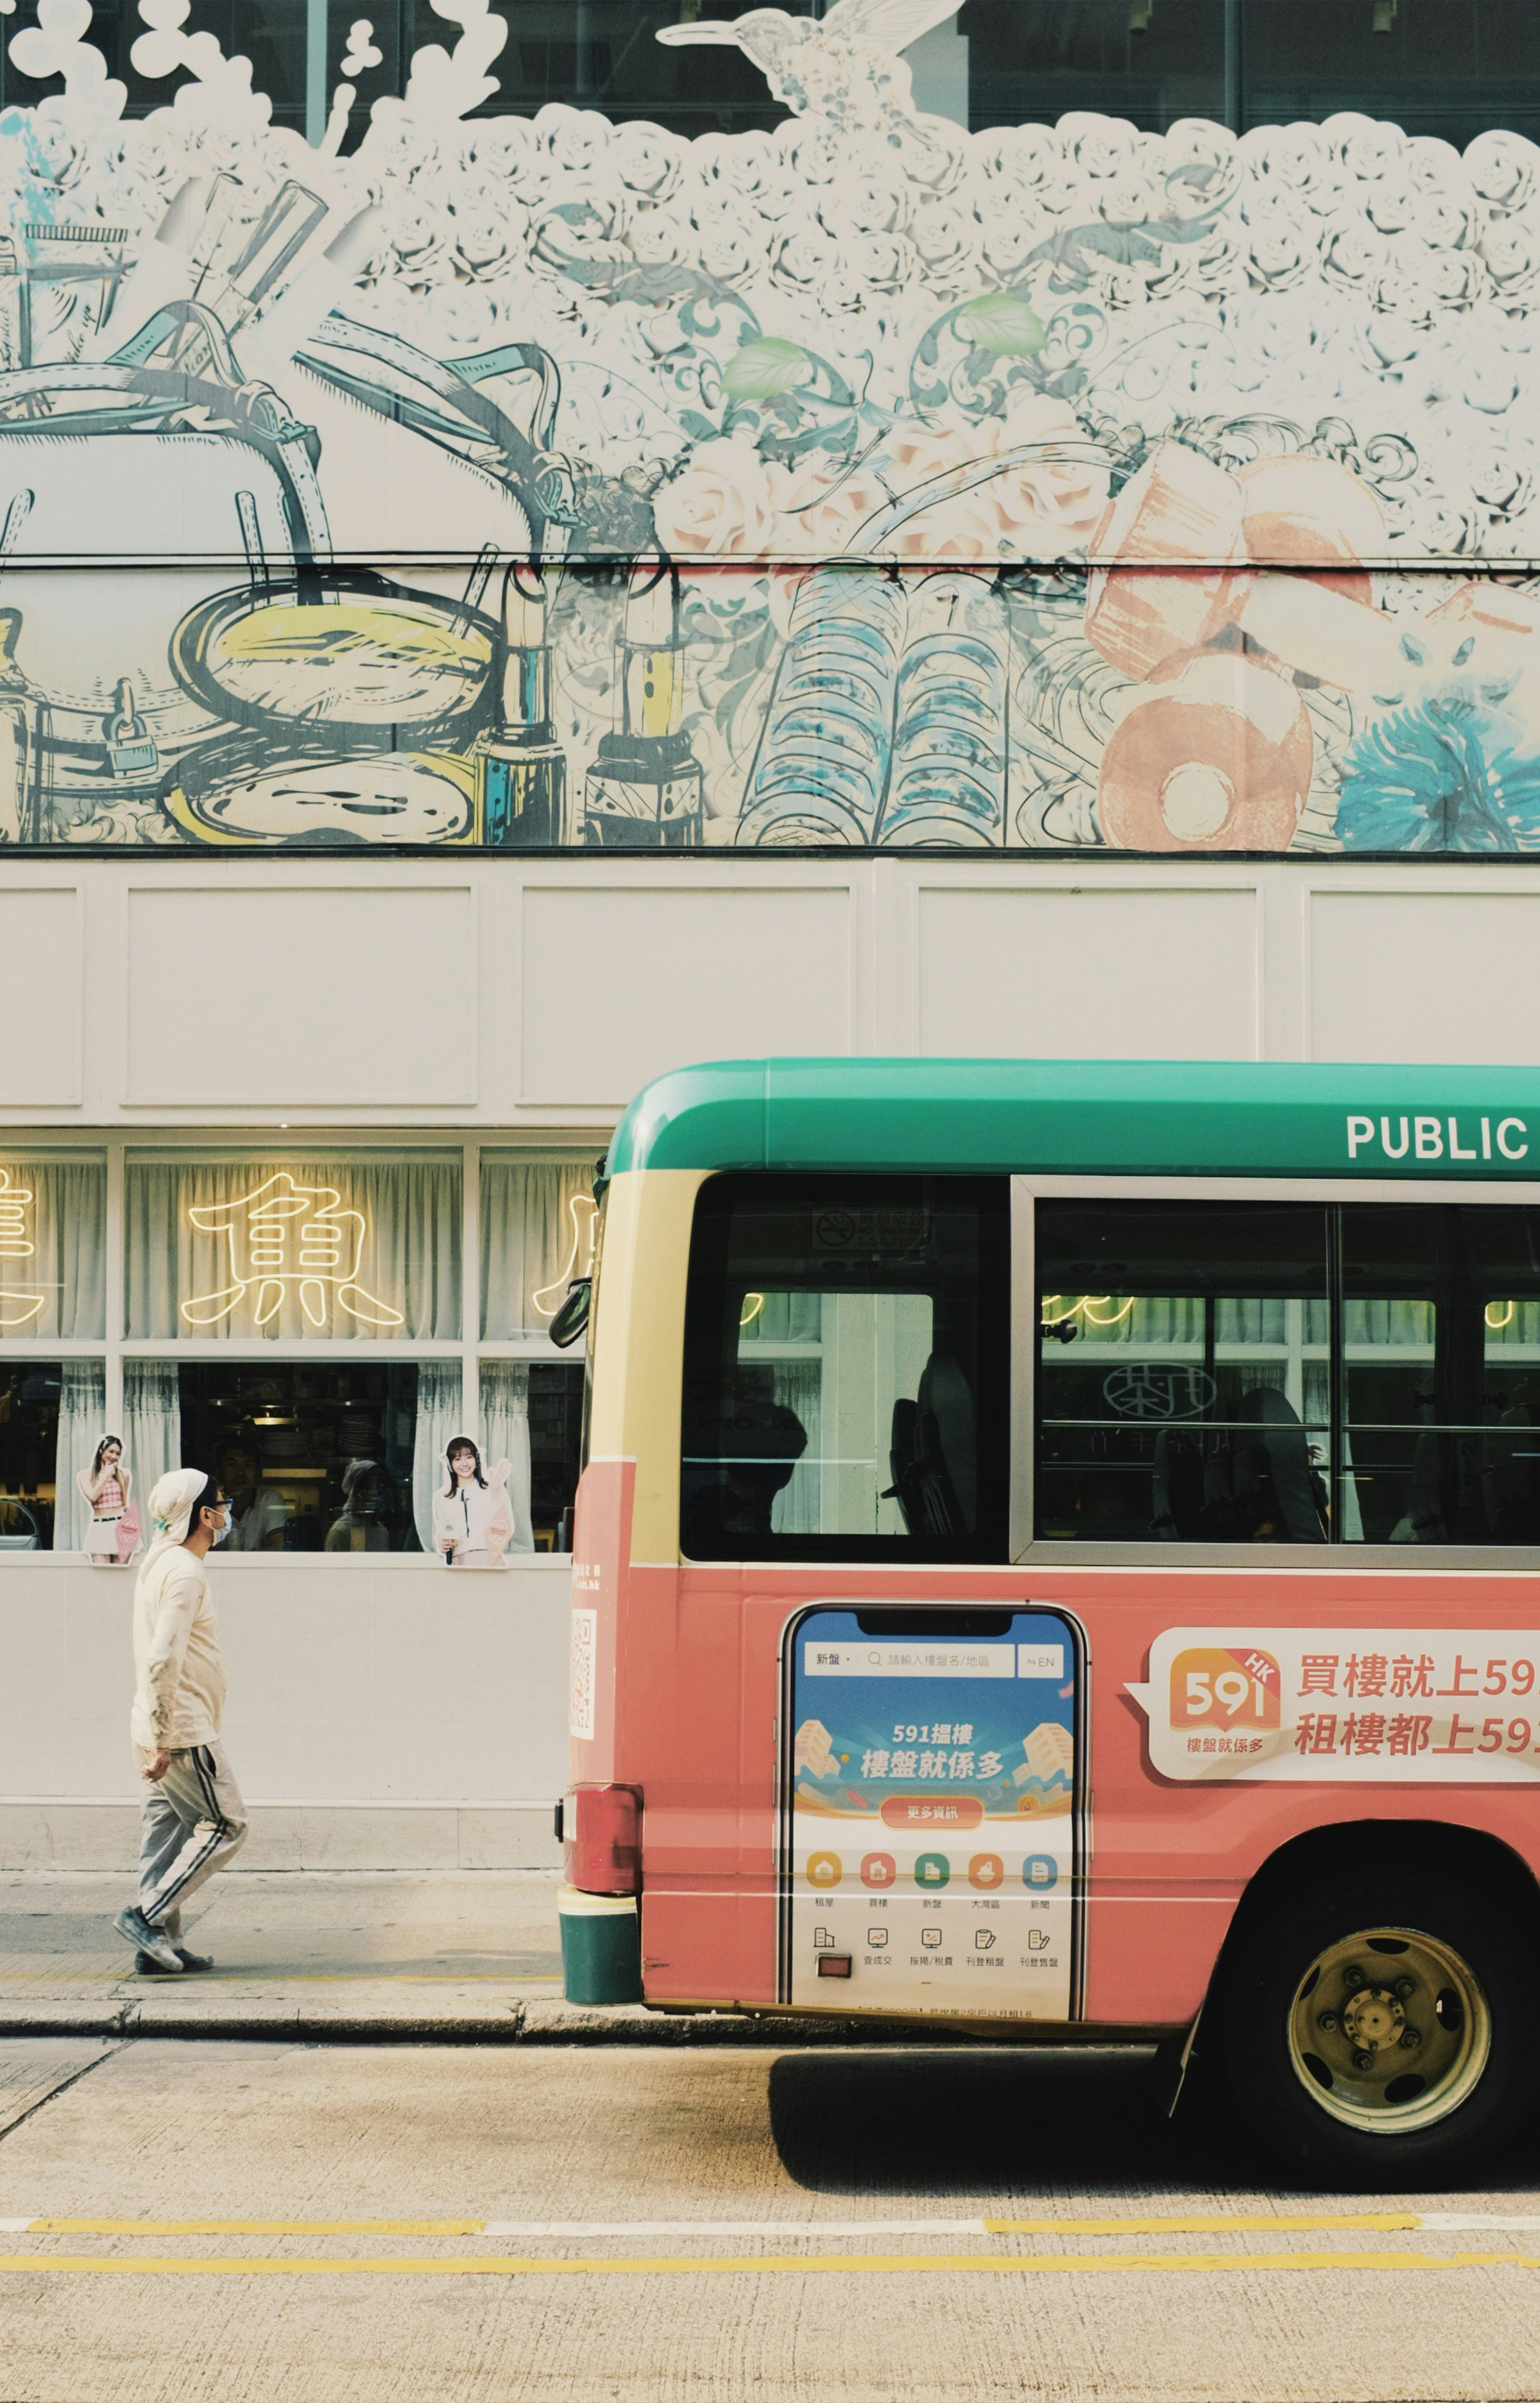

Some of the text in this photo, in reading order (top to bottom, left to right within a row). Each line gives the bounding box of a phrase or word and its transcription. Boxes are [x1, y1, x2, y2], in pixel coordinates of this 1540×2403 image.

[1348, 1115, 1528, 1160] PUBLIC
[858, 1226, 925, 1236] NO SMOKING
[181, 1172, 404, 1325] 魚
[816, 1653, 840, 1666] 新盤
[889, 1654, 989, 1667] 請輸入樓盤名/地區
[1038, 1657, 1054, 1667] EN
[1244, 1653, 1276, 1683] HK
[1296, 1654, 1540, 1698] 買樓就上59
[1186, 1672, 1264, 1716] 591
[1295, 1713, 1540, 1756] 租樓都上59
[1186, 1737, 1263, 1753] 樓盤就係多
[861, 1750, 1004, 1780] 樓盤就係多
[907, 1805, 958, 1820] 更多資訊
[869, 1898, 888, 1908] 買樓
[923, 1899, 942, 1909] 新盤
[971, 1900, 1000, 1909] 大灣區
[1031, 1900, 1050, 1909] 新聞
[864, 1956, 893, 1966] 查成交
[966, 1957, 1004, 1967] 刊登租盤
[1020, 1958, 1058, 1967] 刊登售盤
